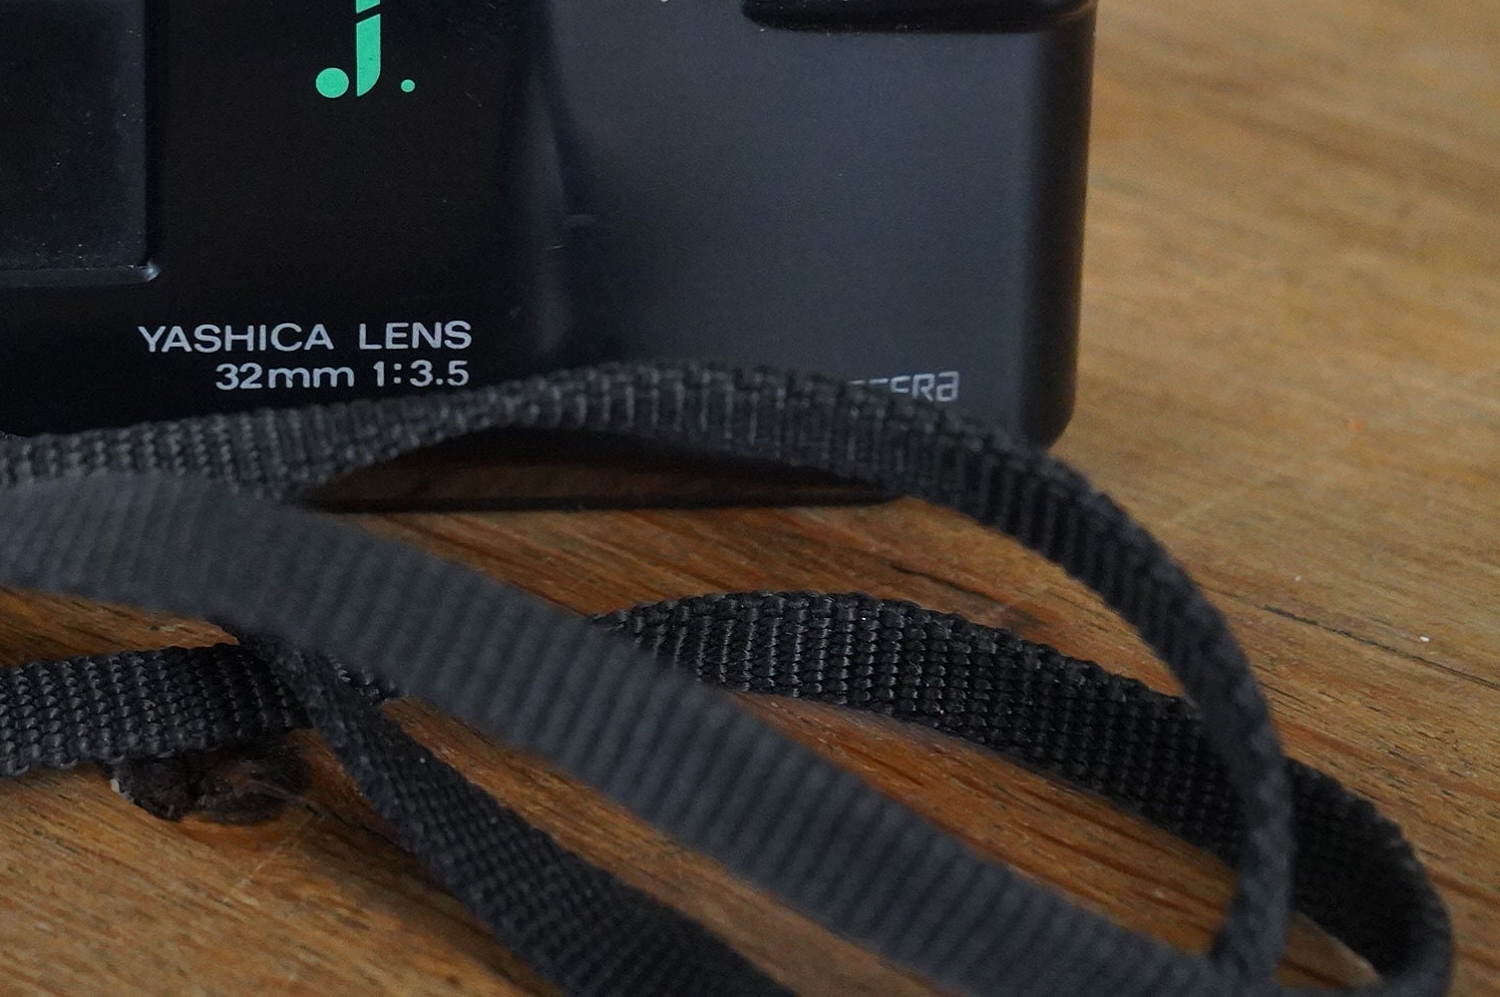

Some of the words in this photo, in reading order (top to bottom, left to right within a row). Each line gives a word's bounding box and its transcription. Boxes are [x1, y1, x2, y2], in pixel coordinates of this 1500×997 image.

[138, 322, 335, 352] YASHICA
[359, 320, 472, 349] LENS
[215, 362, 354, 390] 32mm
[373, 359, 470, 387] 1:3.5
